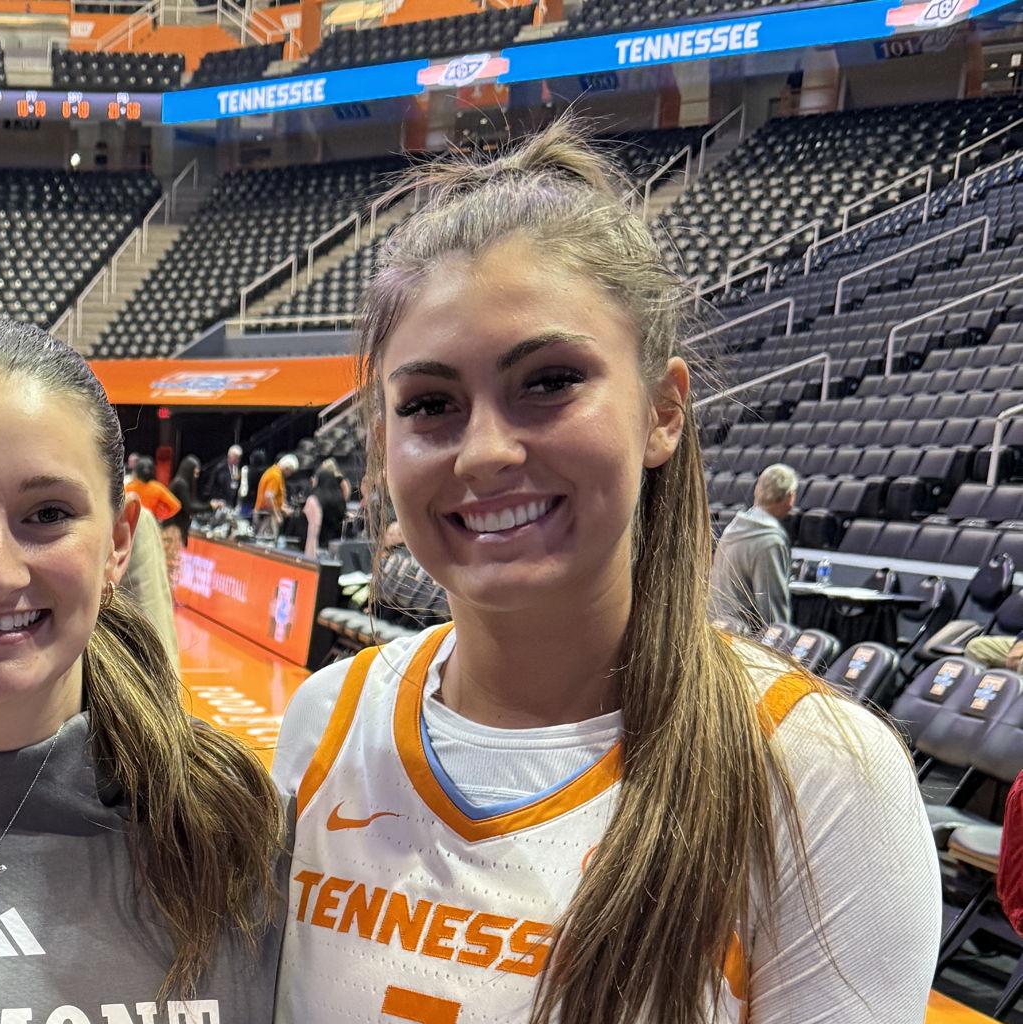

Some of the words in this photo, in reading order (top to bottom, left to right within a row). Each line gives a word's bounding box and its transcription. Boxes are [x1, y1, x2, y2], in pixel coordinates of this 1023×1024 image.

[615, 21, 763, 65] TENNESSEE
[879, 40, 915, 58] 101
[216, 77, 327, 115] TENNESSEE
[293, 869, 556, 978] TENNESS
